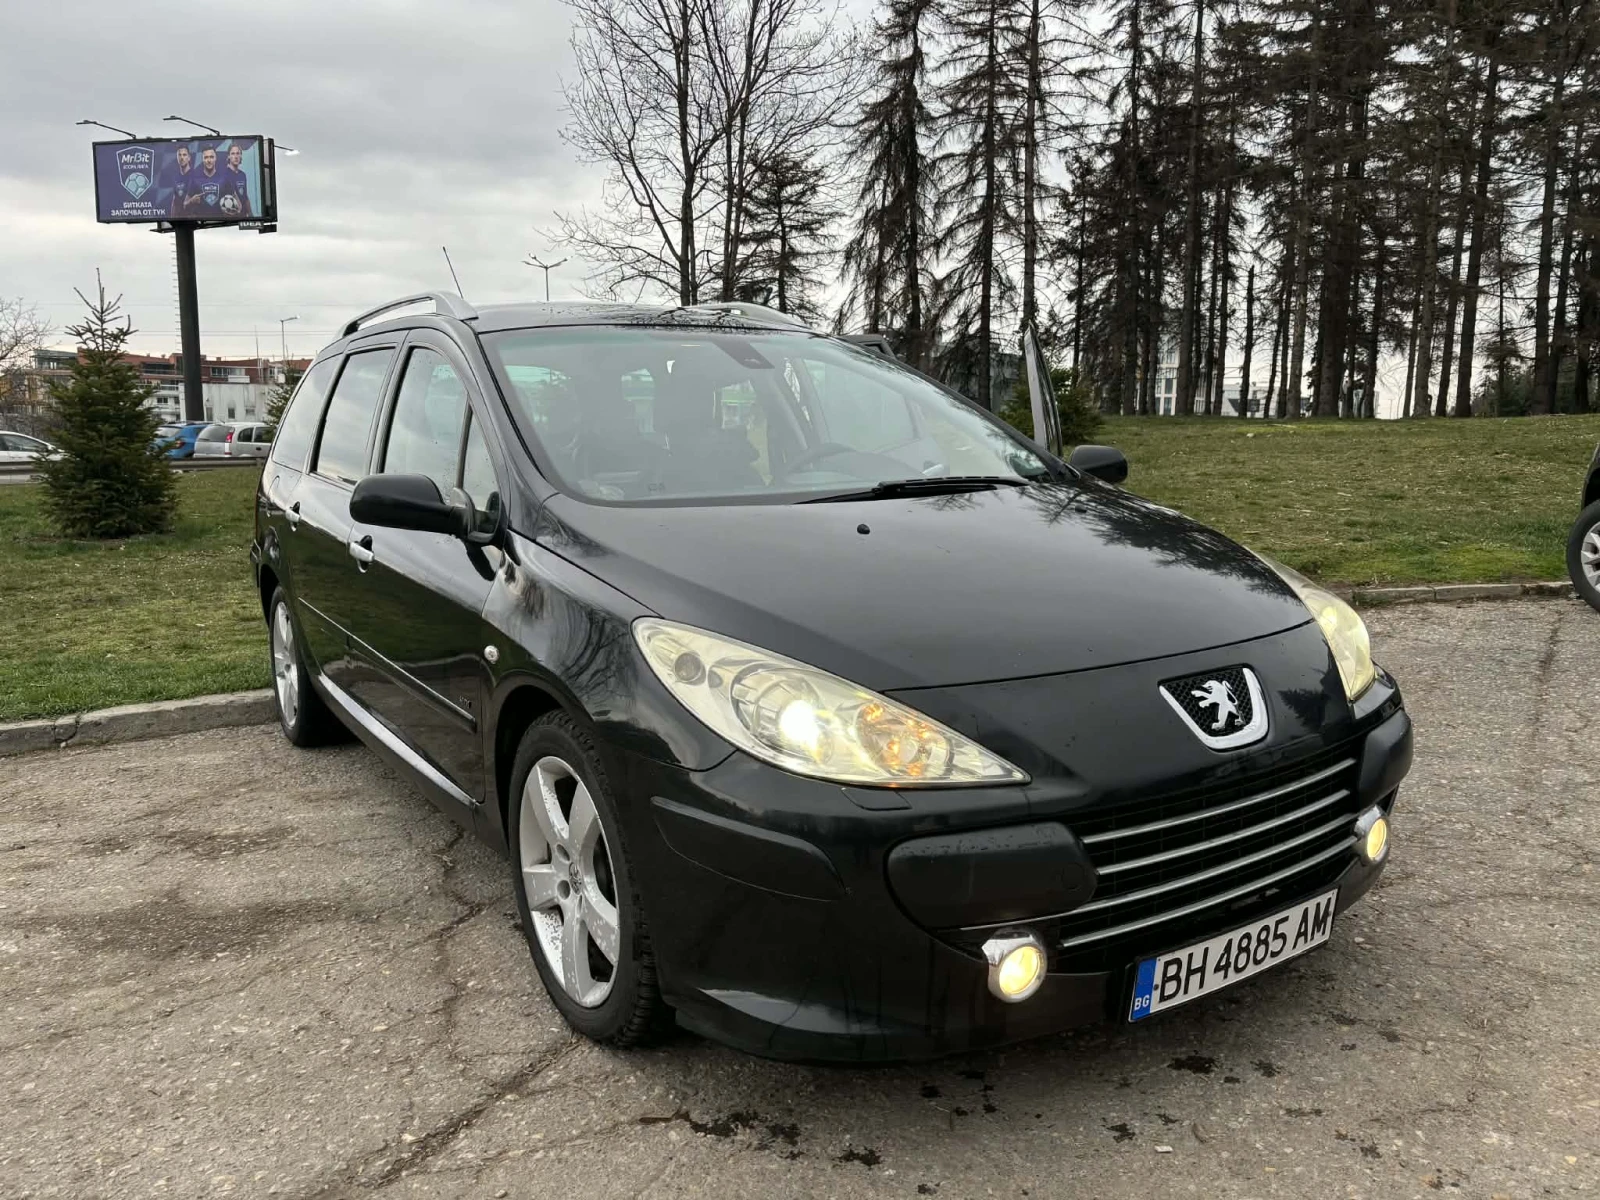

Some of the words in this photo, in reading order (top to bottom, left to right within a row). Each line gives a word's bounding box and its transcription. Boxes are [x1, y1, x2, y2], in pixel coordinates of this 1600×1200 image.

[121, 152, 150, 164] MrBit
[122, 201, 153, 209] БИТКАТА
[110, 209, 142, 217] ЗАПОЧВА
[142, 208, 152, 216] ОТ
[152, 208, 166, 216] ТУК
[1158, 946, 1209, 1003] BH
[1213, 915, 1290, 980] 4885
[1292, 897, 1332, 950] AM
[1133, 995, 1150, 1011] BG
